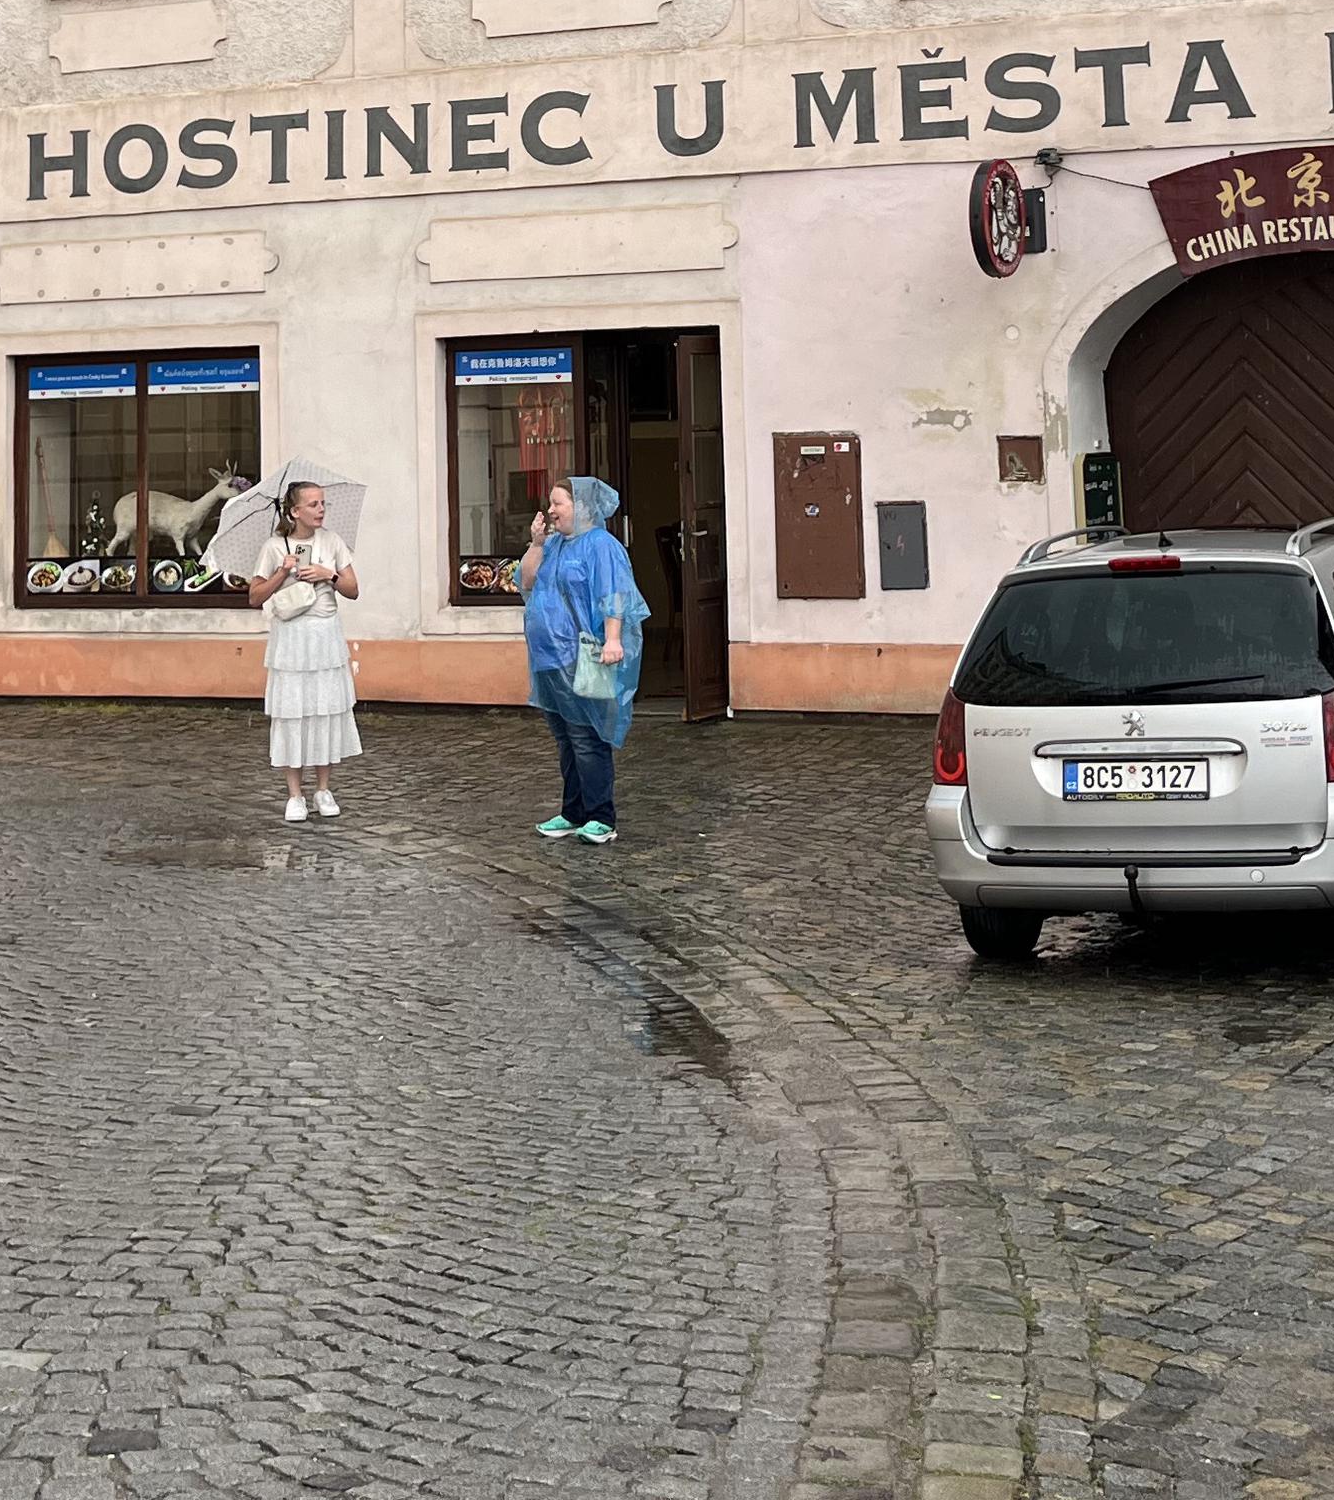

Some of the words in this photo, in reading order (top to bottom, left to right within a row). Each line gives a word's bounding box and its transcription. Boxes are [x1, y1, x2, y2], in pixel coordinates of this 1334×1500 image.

[26, 90, 593, 202] HOSTINEC
[653, 79, 727, 157] U
[790, 47, 1257, 149] MĚSTA
[1186, 223, 1258, 262] CHINA
[1066, 781, 1077, 789] CZ
[1083, 765, 1123, 789] 8C5
[1141, 765, 1196, 789] 3127
